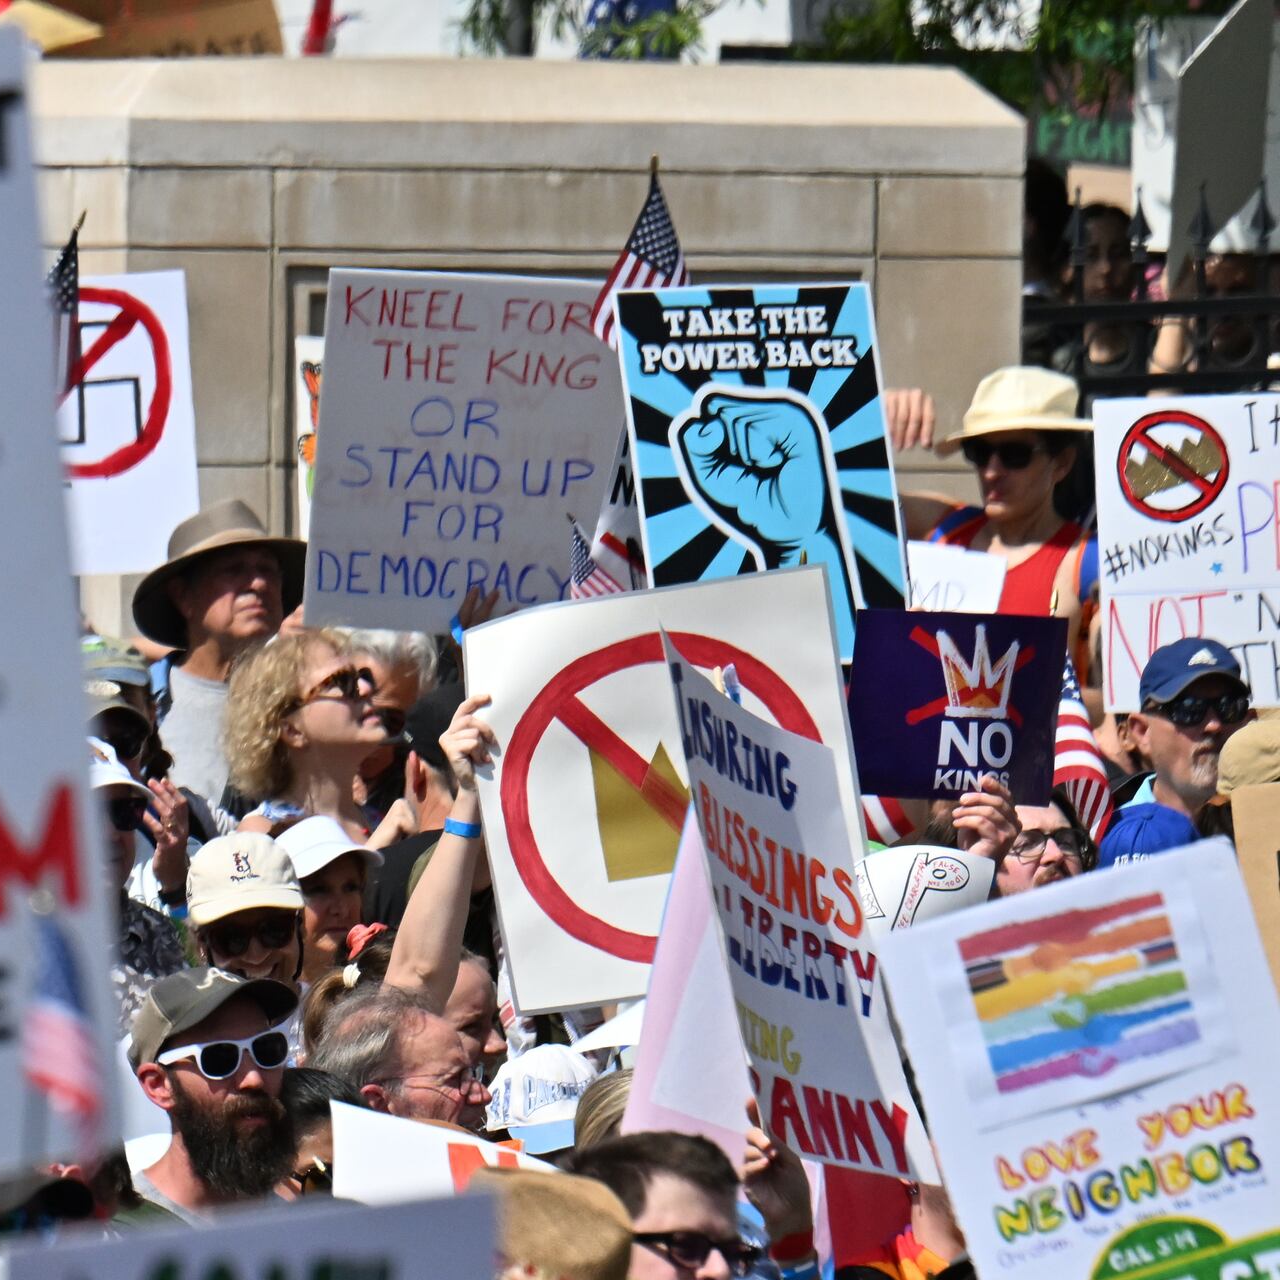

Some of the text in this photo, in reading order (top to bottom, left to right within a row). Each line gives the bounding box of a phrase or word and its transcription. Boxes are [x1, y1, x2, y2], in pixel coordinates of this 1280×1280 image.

[344, 286, 595, 338] KNEEL FOR
[662, 306, 828, 337] TAKE THE
[374, 339, 603, 391] THE KING
[640, 338, 858, 374] POWER BACK
[409, 395, 499, 440] OR
[340, 444, 501, 495] STAND
[522, 458, 595, 498] UP
[402, 502, 505, 544] FOR
[1104, 512, 1234, 583] #NOKINGS
[318, 550, 574, 606] DEMOCRACY
[937, 720, 1013, 768] NO
[697, 790, 864, 939] BLESSINGS
[725, 884, 880, 1018] LIBERTY
[740, 1004, 803, 1076] ING
[751, 1070, 909, 1175] ANNY
[994, 1127, 1101, 1191] LOVE
[1137, 1083, 1256, 1152] YOUR
